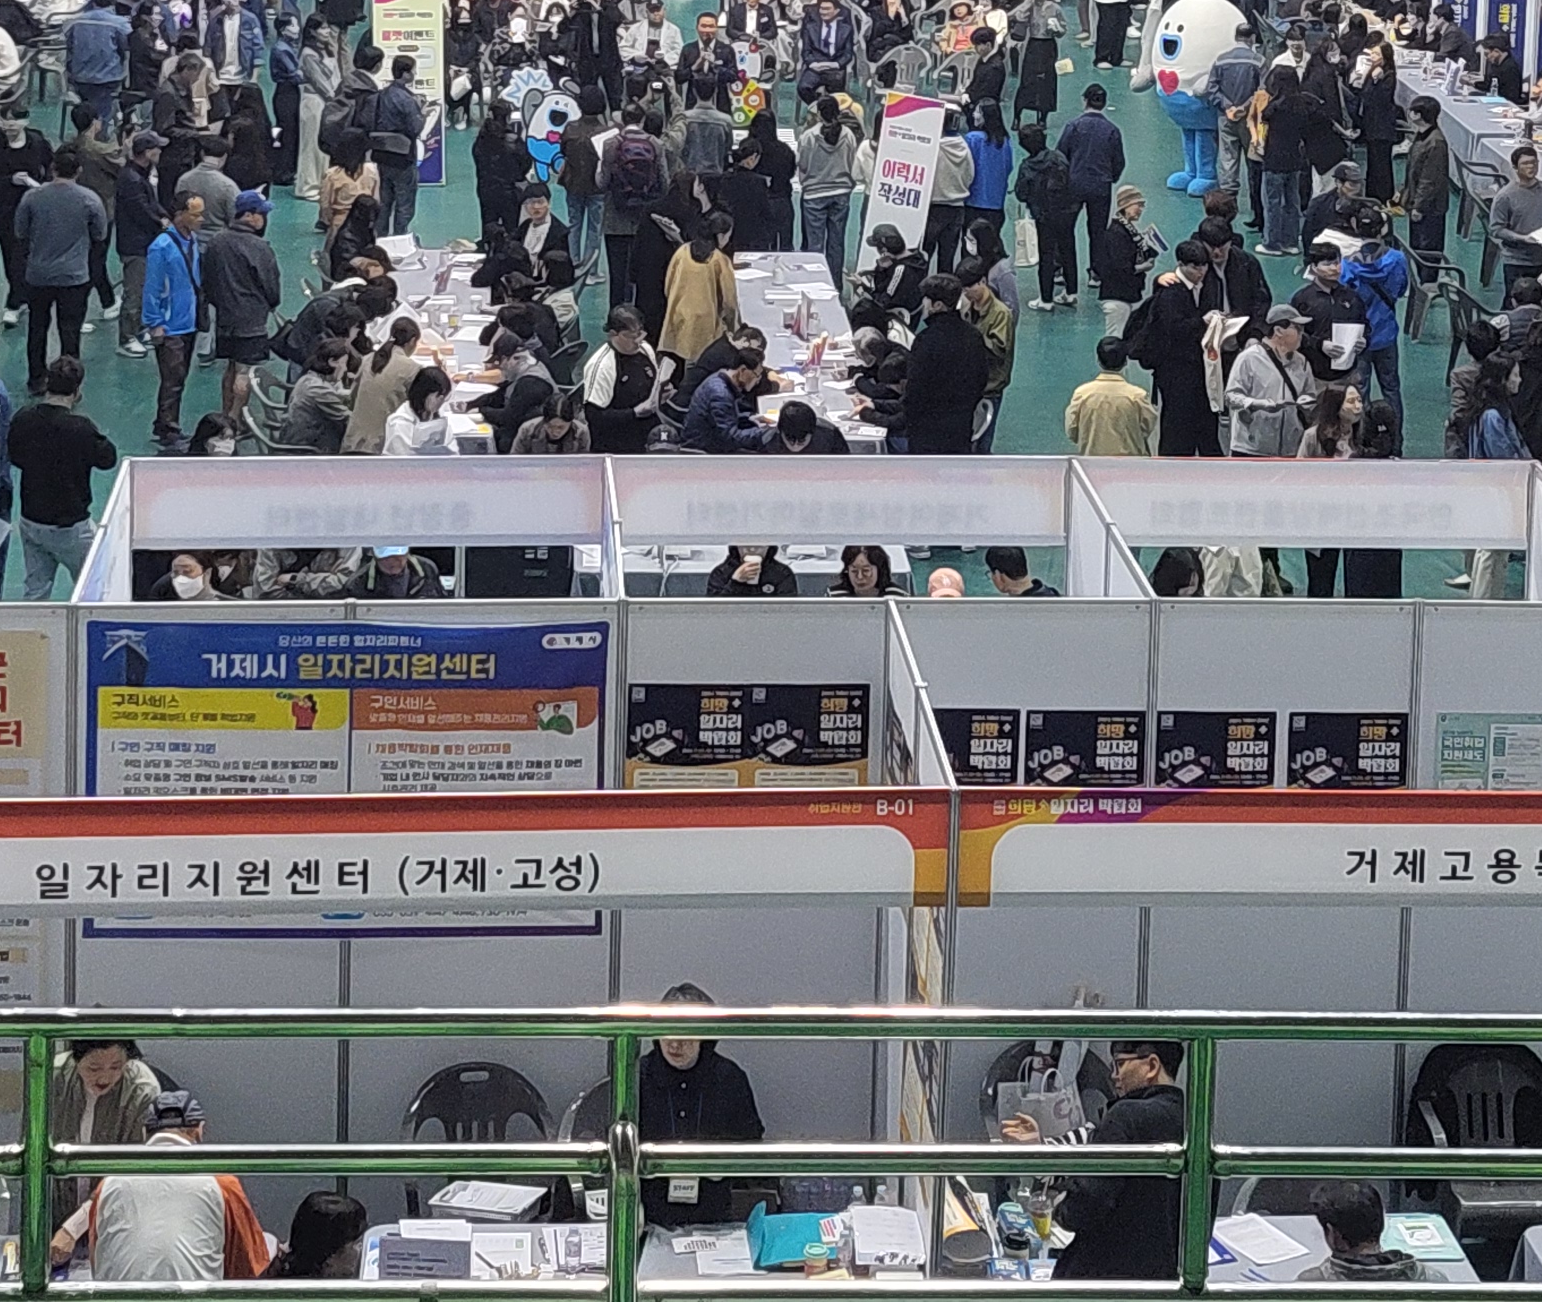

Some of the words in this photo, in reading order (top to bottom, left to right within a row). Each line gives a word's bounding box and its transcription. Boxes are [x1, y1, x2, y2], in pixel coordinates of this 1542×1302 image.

[882, 159, 926, 185] 이력서
[877, 182, 922, 209] 작성대
[201, 652, 288, 680] 거제시
[297, 652, 497, 681] 일자리지원센터
[111, 693, 181, 709] 구직서비스
[369, 694, 438, 711] 구인서비스
[629, 719, 669, 743] JOB
[698, 714, 743, 730] 일자리
[749, 719, 789, 743] JOB
[819, 714, 863, 730] 일자리
[970, 738, 1013, 754] 일자리
[1095, 739, 1139, 755] 일자리
[1226, 740, 1269, 756] 일자리
[1358, 741, 1401, 757] 일자리
[1027, 745, 1066, 770] JOB
[1158, 746, 1197, 770] JOB
[1290, 747, 1328, 771] JOB
[876, 798, 915, 816] B-01
[1049, 798, 1095, 815] 일자리
[1097, 798, 1143, 815] 박람회
[35, 858, 371, 899] 일자리지원센터
